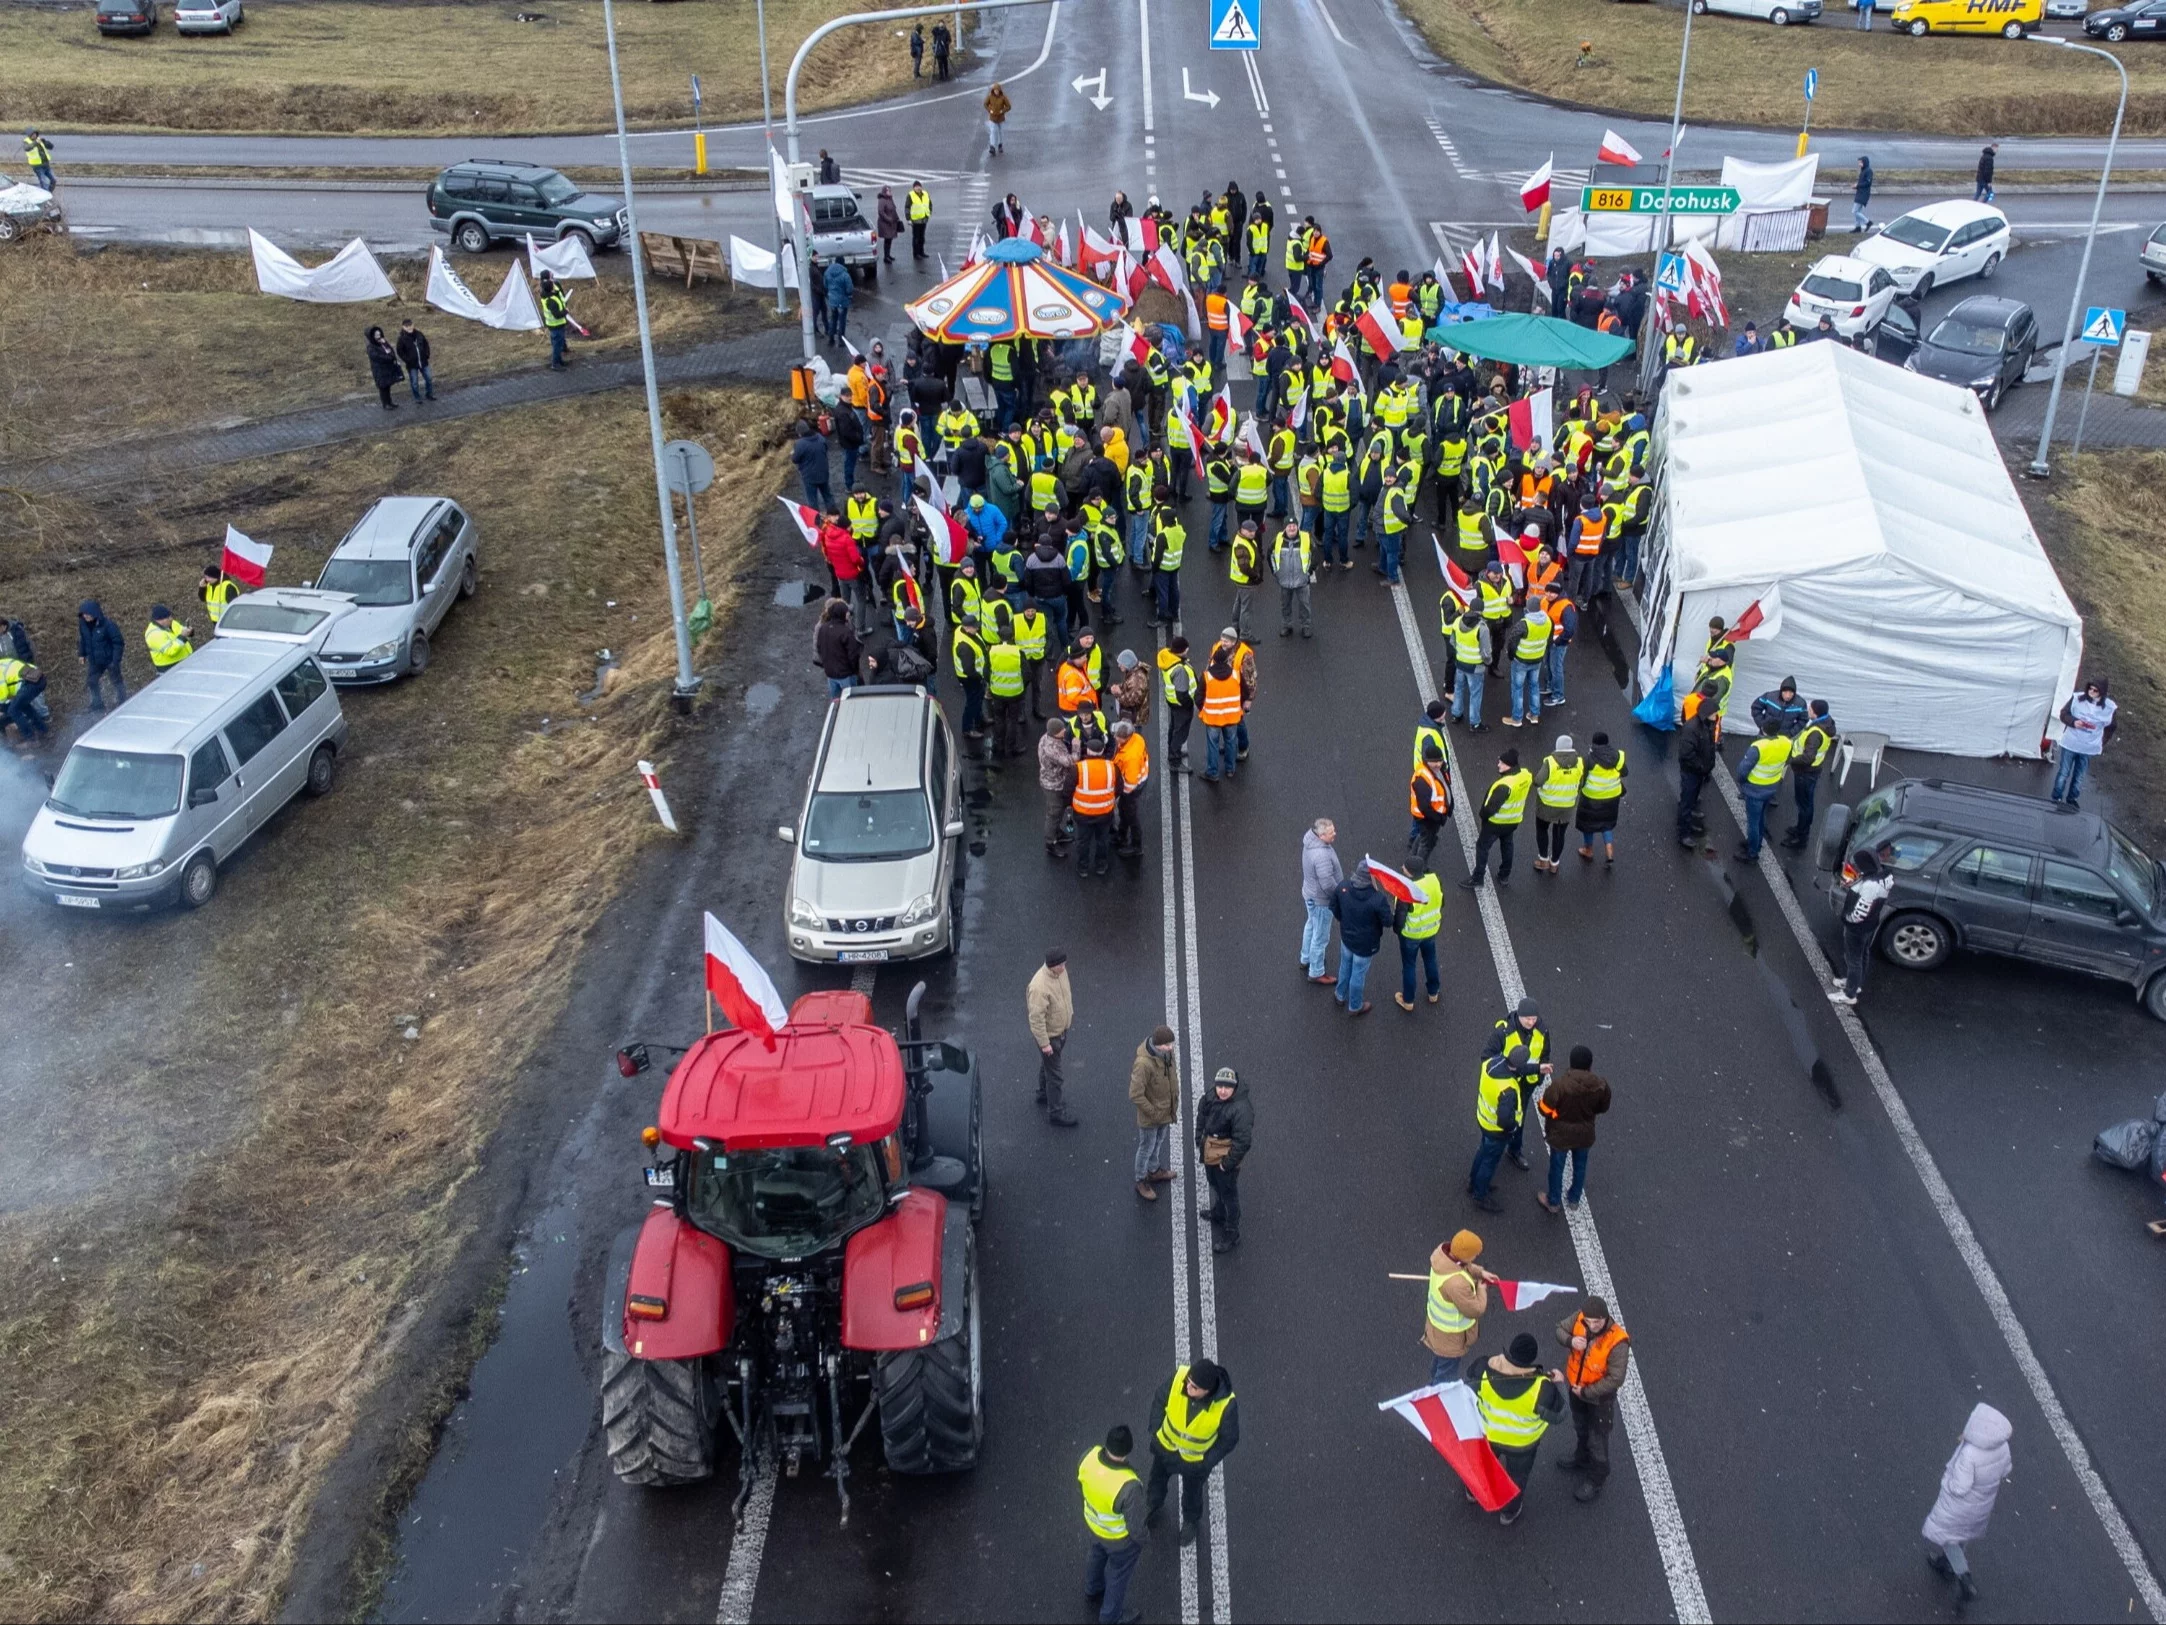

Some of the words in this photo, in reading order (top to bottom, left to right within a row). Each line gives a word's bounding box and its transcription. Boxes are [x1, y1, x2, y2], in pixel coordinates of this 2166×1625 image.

[1967, 0, 2027, 13] RMF
[1598, 193, 1624, 207] 816
[1639, 192, 1732, 209] Dorohusk
